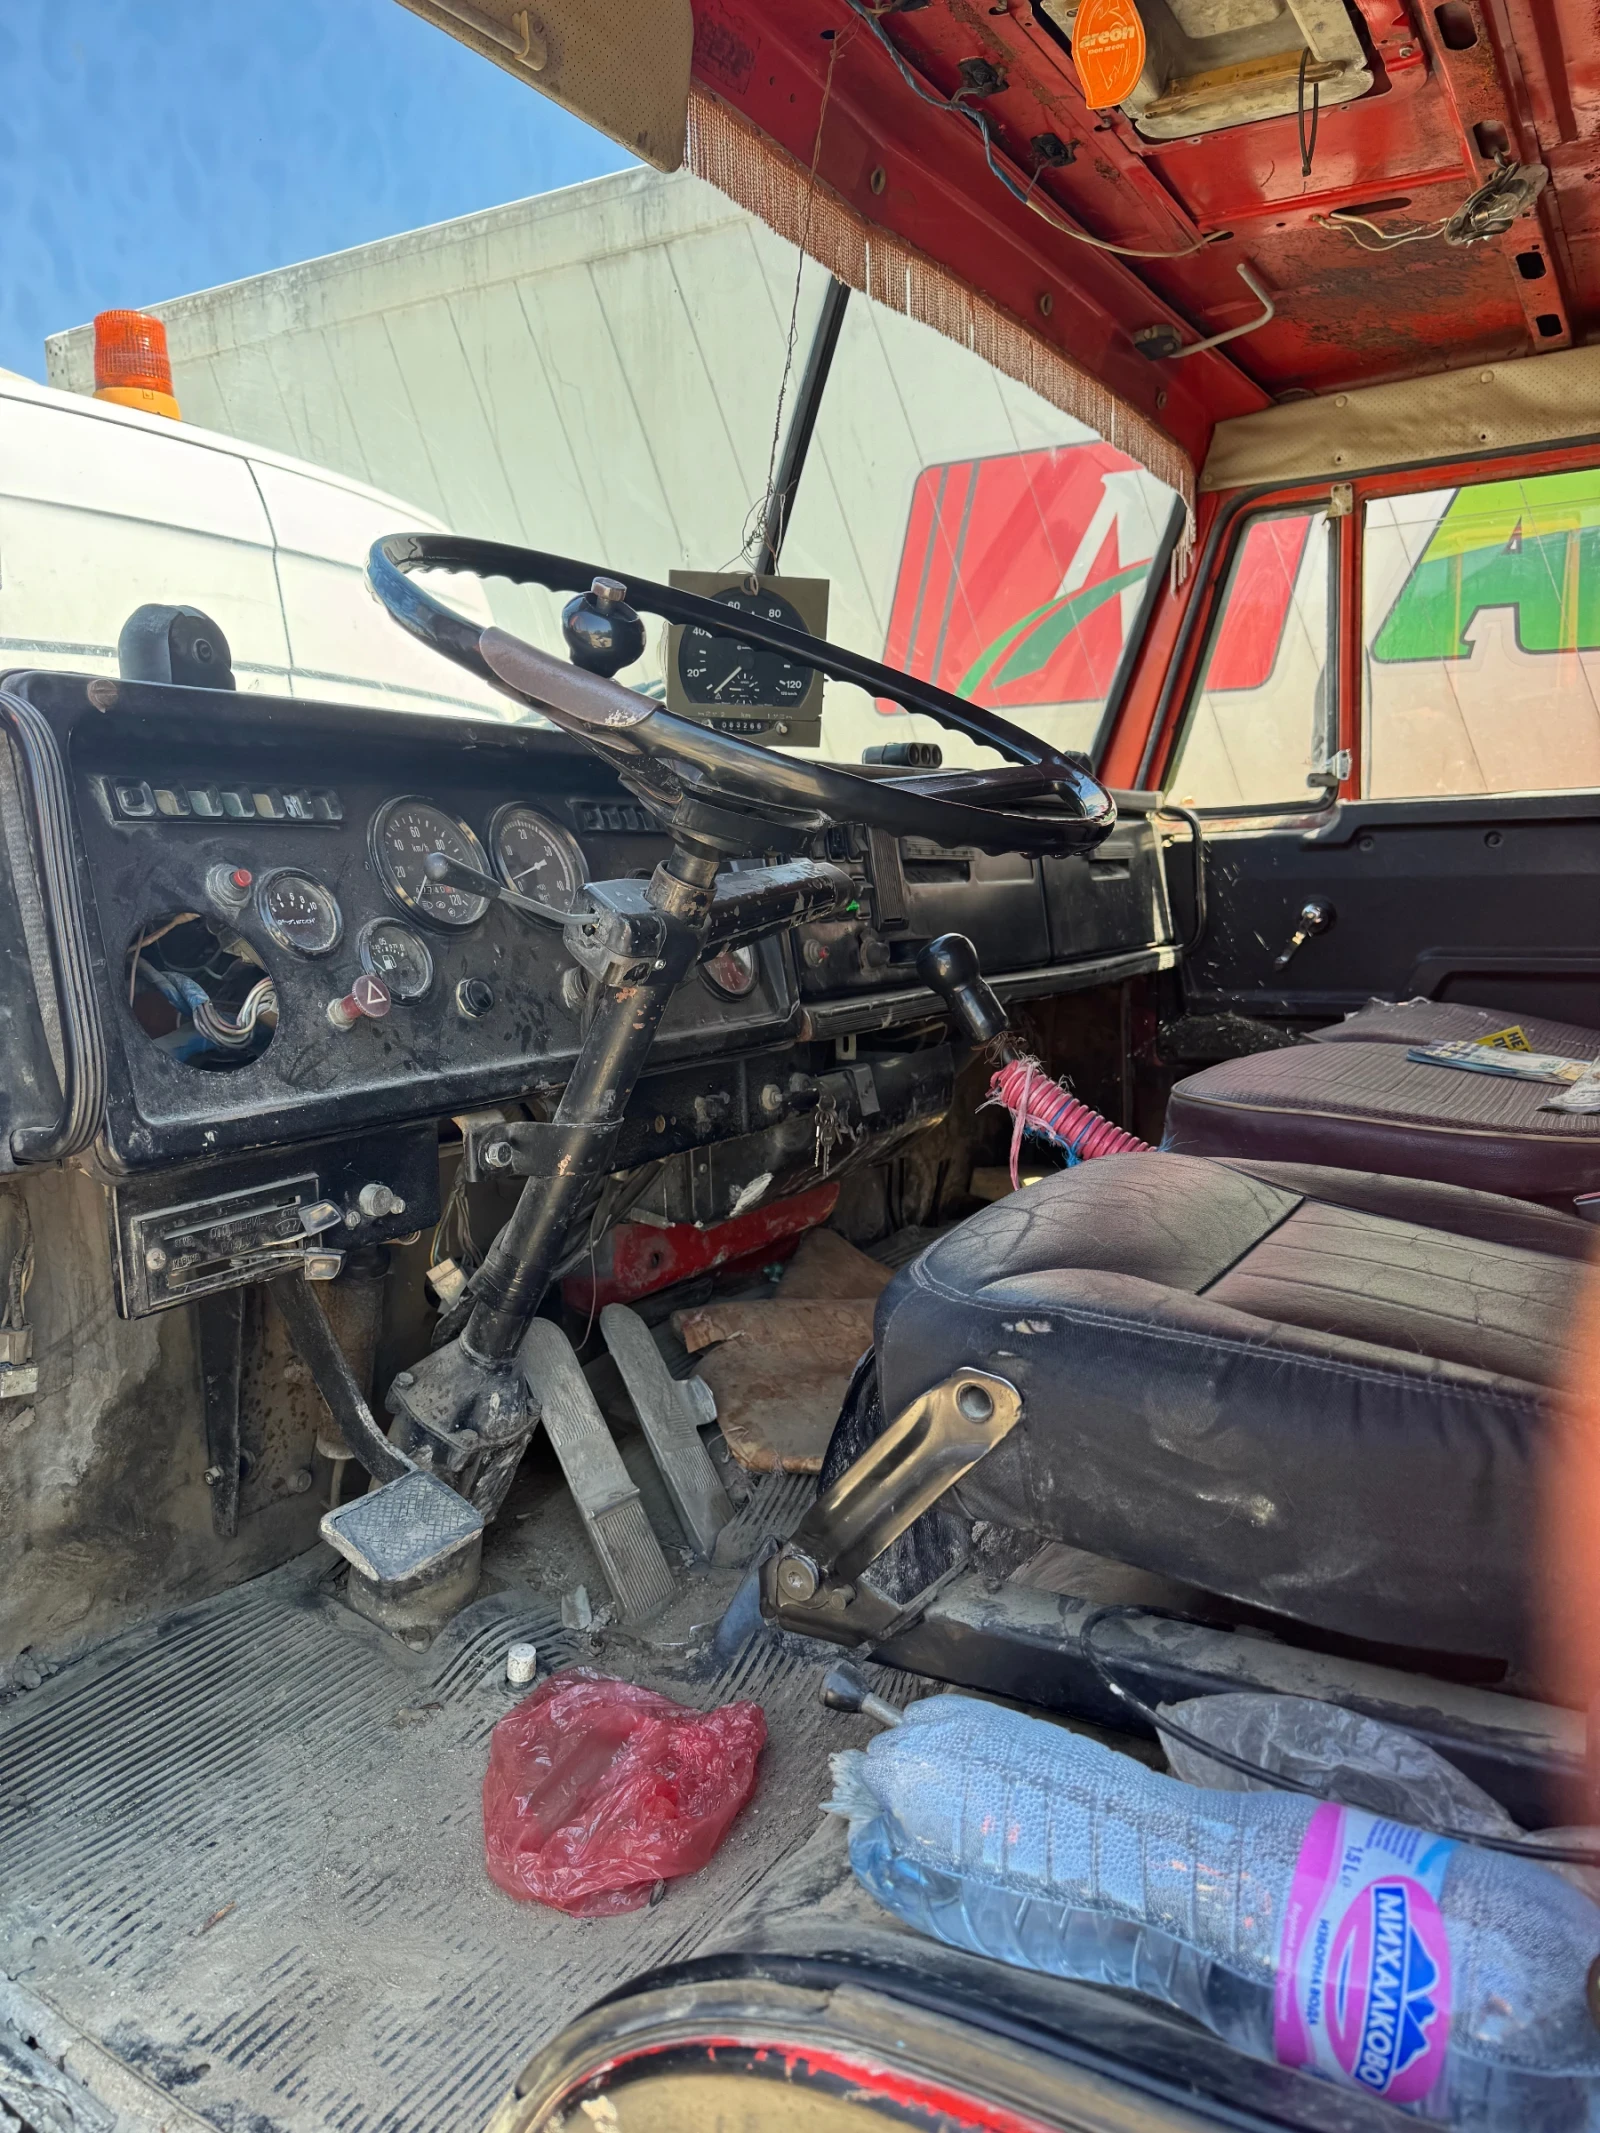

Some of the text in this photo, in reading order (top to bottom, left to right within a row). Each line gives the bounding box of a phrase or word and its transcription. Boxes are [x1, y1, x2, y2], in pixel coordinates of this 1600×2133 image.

[1079, 25, 1135, 48] areon
[768, 608, 782, 618] 80
[687, 669, 700, 677] 20
[786, 680, 802, 689] 120
[409, 826, 421, 838] 60
[518, 828, 528, 840] 20
[394, 839, 404, 851] 40
[435, 839, 446, 851] 80
[544, 845, 553, 857] 30
[395, 866, 406, 878] 20
[309, 901, 318, 911] 10
[449, 894, 462, 906] 120
[1360, 1892, 1404, 2087] МИХАЛКОВО
[1306, 1986, 1321, 2026] ВОДА
